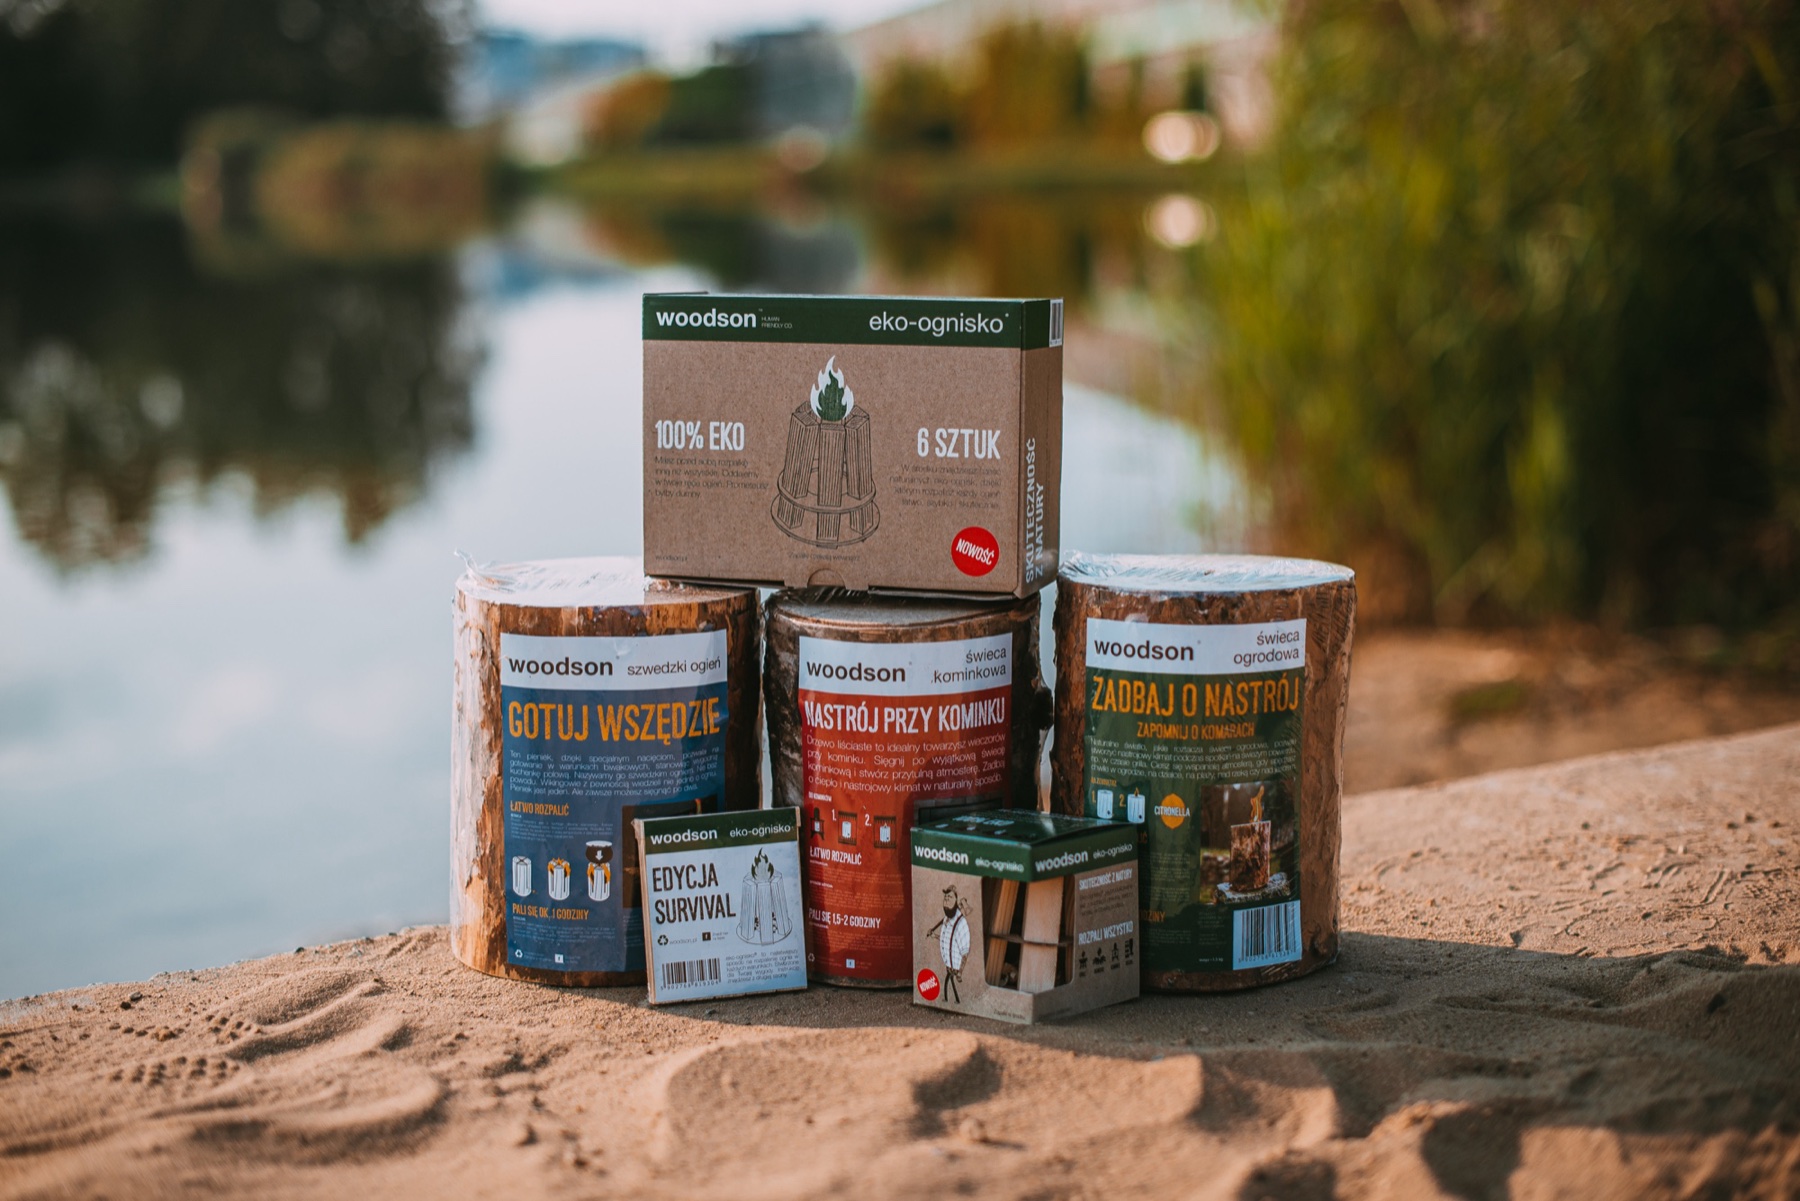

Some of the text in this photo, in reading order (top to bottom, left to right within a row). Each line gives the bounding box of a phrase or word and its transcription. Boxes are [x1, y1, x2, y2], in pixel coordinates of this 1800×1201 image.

[656, 308, 756, 328] woodson
[869, 312, 1004, 337] eko-ognisko
[655, 420, 745, 451] 100% EKO
[917, 427, 1000, 460] 6 SZTUK
[1026, 438, 1035, 584] SKUTECZNOŚĆ
[1035, 483, 1044, 560] NATURY
[956, 538, 994, 566] NOWOŚĆ
[1256, 630, 1299, 646] świeca
[966, 647, 1007, 664] świeca
[1094, 640, 1194, 661] woodson
[1233, 647, 1299, 667] ogrodowa
[508, 656, 722, 676] woodson szwedzki ogień
[807, 661, 906, 682] woodson
[933, 664, 1006, 684] kominkowa
[1092, 672, 1299, 717] ZADBAJ O NASTRÓJ
[508, 697, 720, 746] GOTUJ WSZĘDZIE
[804, 697, 1005, 734] NASTRÓJ PRZY KOMINKU
[1137, 722, 1255, 741] ZAPOMNIJ O KOMARACH
[837, 740, 872, 752] liściaste
[875, 743, 884, 752] to
[887, 742, 920, 754] idealny
[923, 740, 966, 753] towarzysz
[828, 752, 866, 764] kominku.
[874, 754, 905, 768] Sięgnij
[912, 757, 925, 766] po
[932, 752, 976, 765] wyjątkową
[859, 768, 888, 779] stwórz
[892, 769, 933, 781] przytulną
[844, 781, 891, 794] nastrojowy
[894, 782, 920, 793] klimat
[934, 779, 973, 791] naturalny
[510, 800, 569, 816] ŁATWO ROZPALIĆ
[1119, 793, 1126, 807] 2.
[865, 814, 872, 827] 2.
[1154, 805, 1190, 816] CITRONELLA
[651, 824, 791, 845] woodson eko-ognisko
[810, 846, 830, 861] ŁATWO
[831, 850, 862, 866] ROZPALIĆ
[915, 845, 1024, 873] woodson eko-ognisko
[1036, 850, 1088, 872] woodson
[652, 862, 718, 892] EDYCJA
[512, 903, 527, 916] PALI
[528, 905, 538, 918] SIĘ
[552, 908, 556, 919] 1
[556, 908, 590, 921] GODZINY
[654, 893, 736, 925] SURVIVAL
[809, 908, 821, 921] PALI
[822, 911, 831, 925] SIĘ
[850, 916, 881, 929] GODZINY
[1103, 920, 1134, 939] WSZYSTKO
